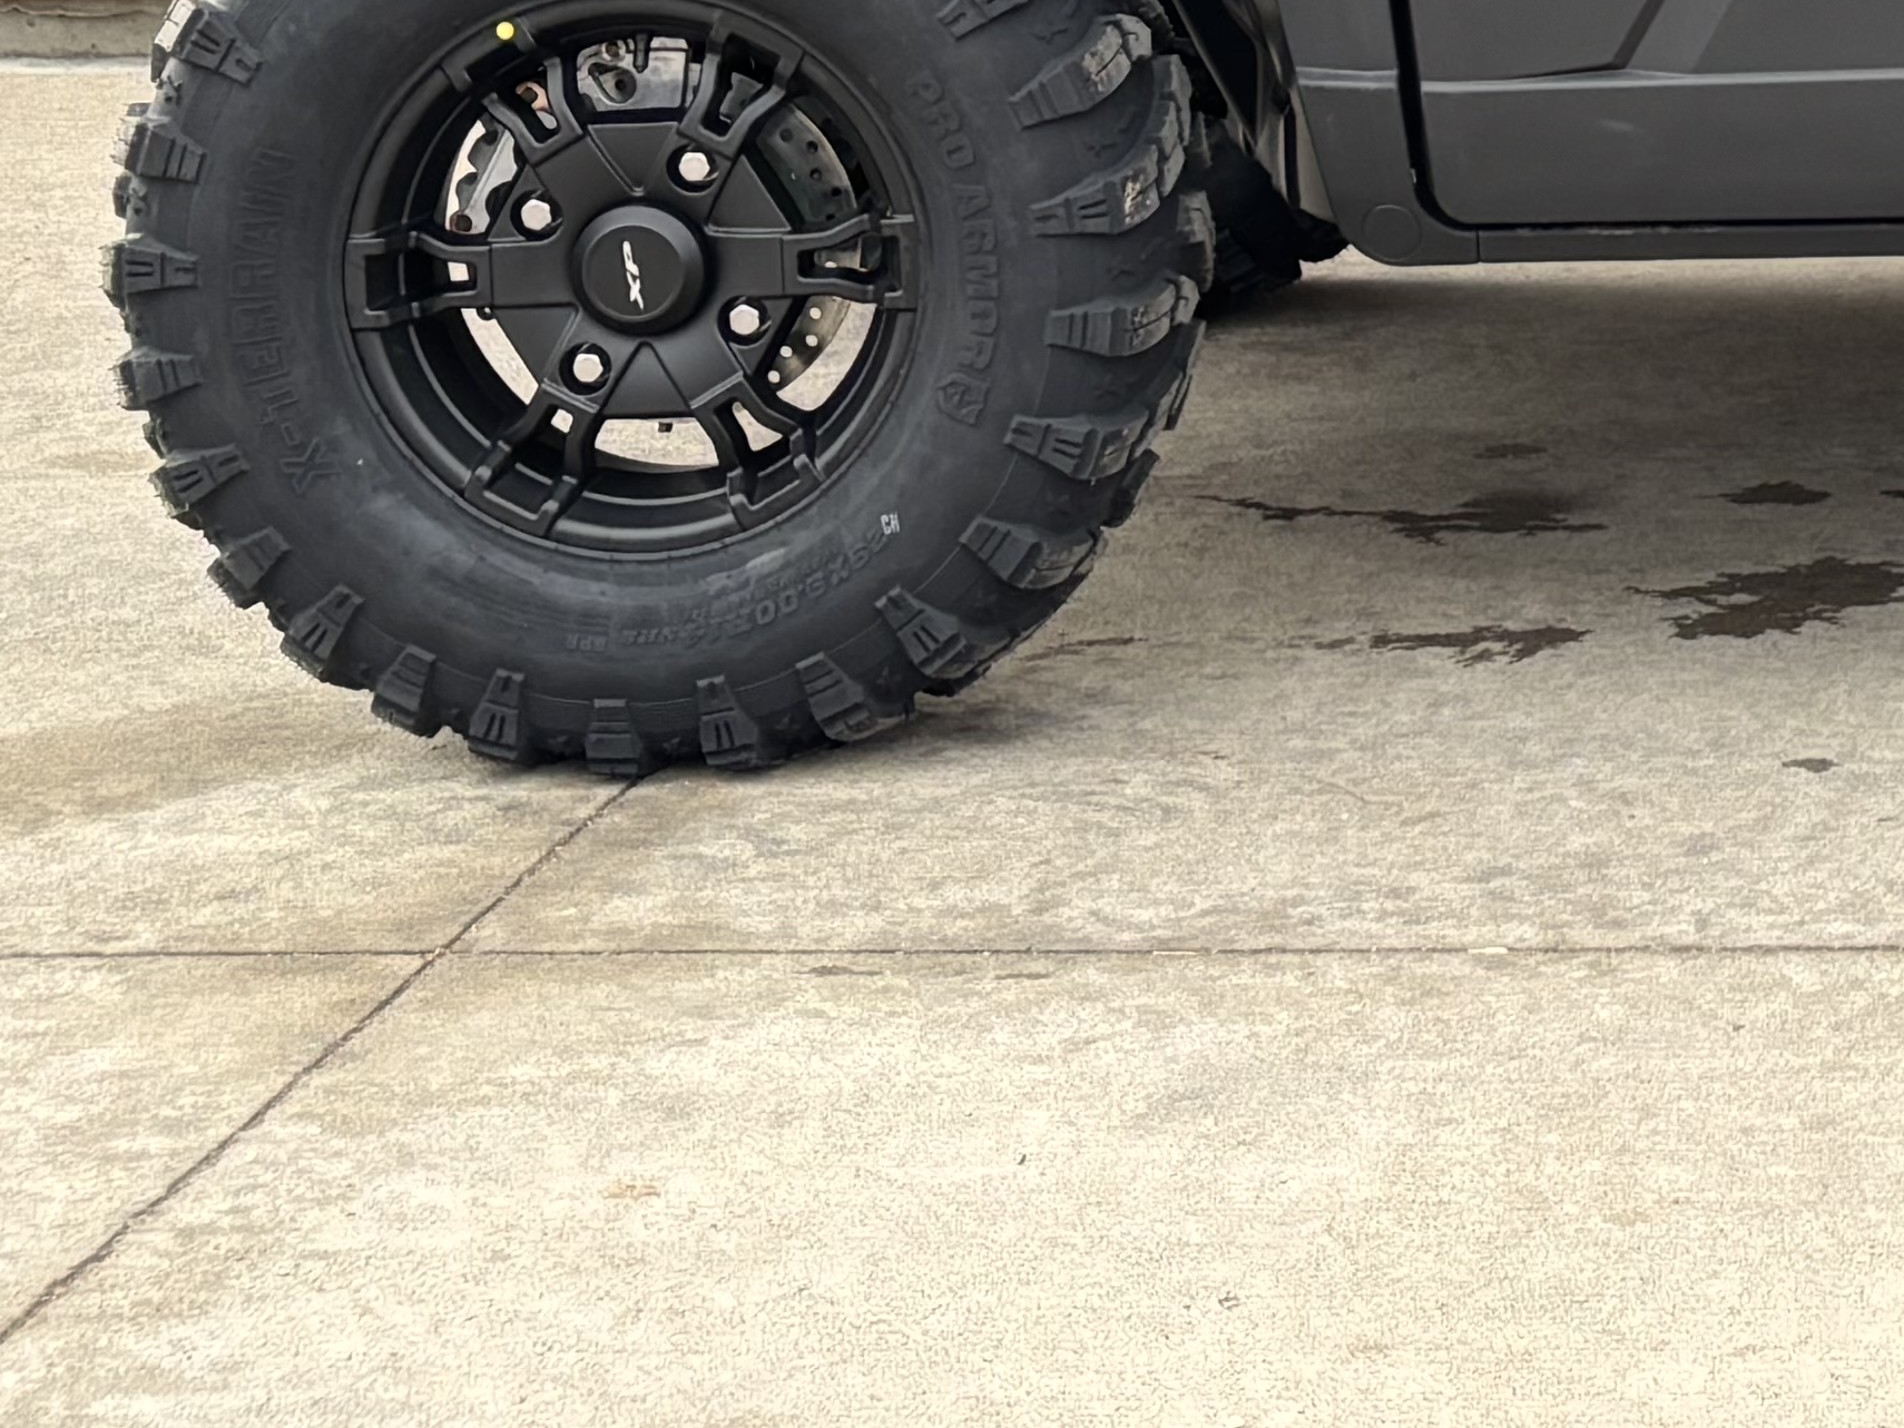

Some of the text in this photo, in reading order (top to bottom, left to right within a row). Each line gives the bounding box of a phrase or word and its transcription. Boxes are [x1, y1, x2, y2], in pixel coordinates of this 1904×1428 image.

[230, 142, 340, 498] X-TERRAIN
[622, 241, 645, 310] XP
[903, 66, 999, 372] PRO ARMOR
